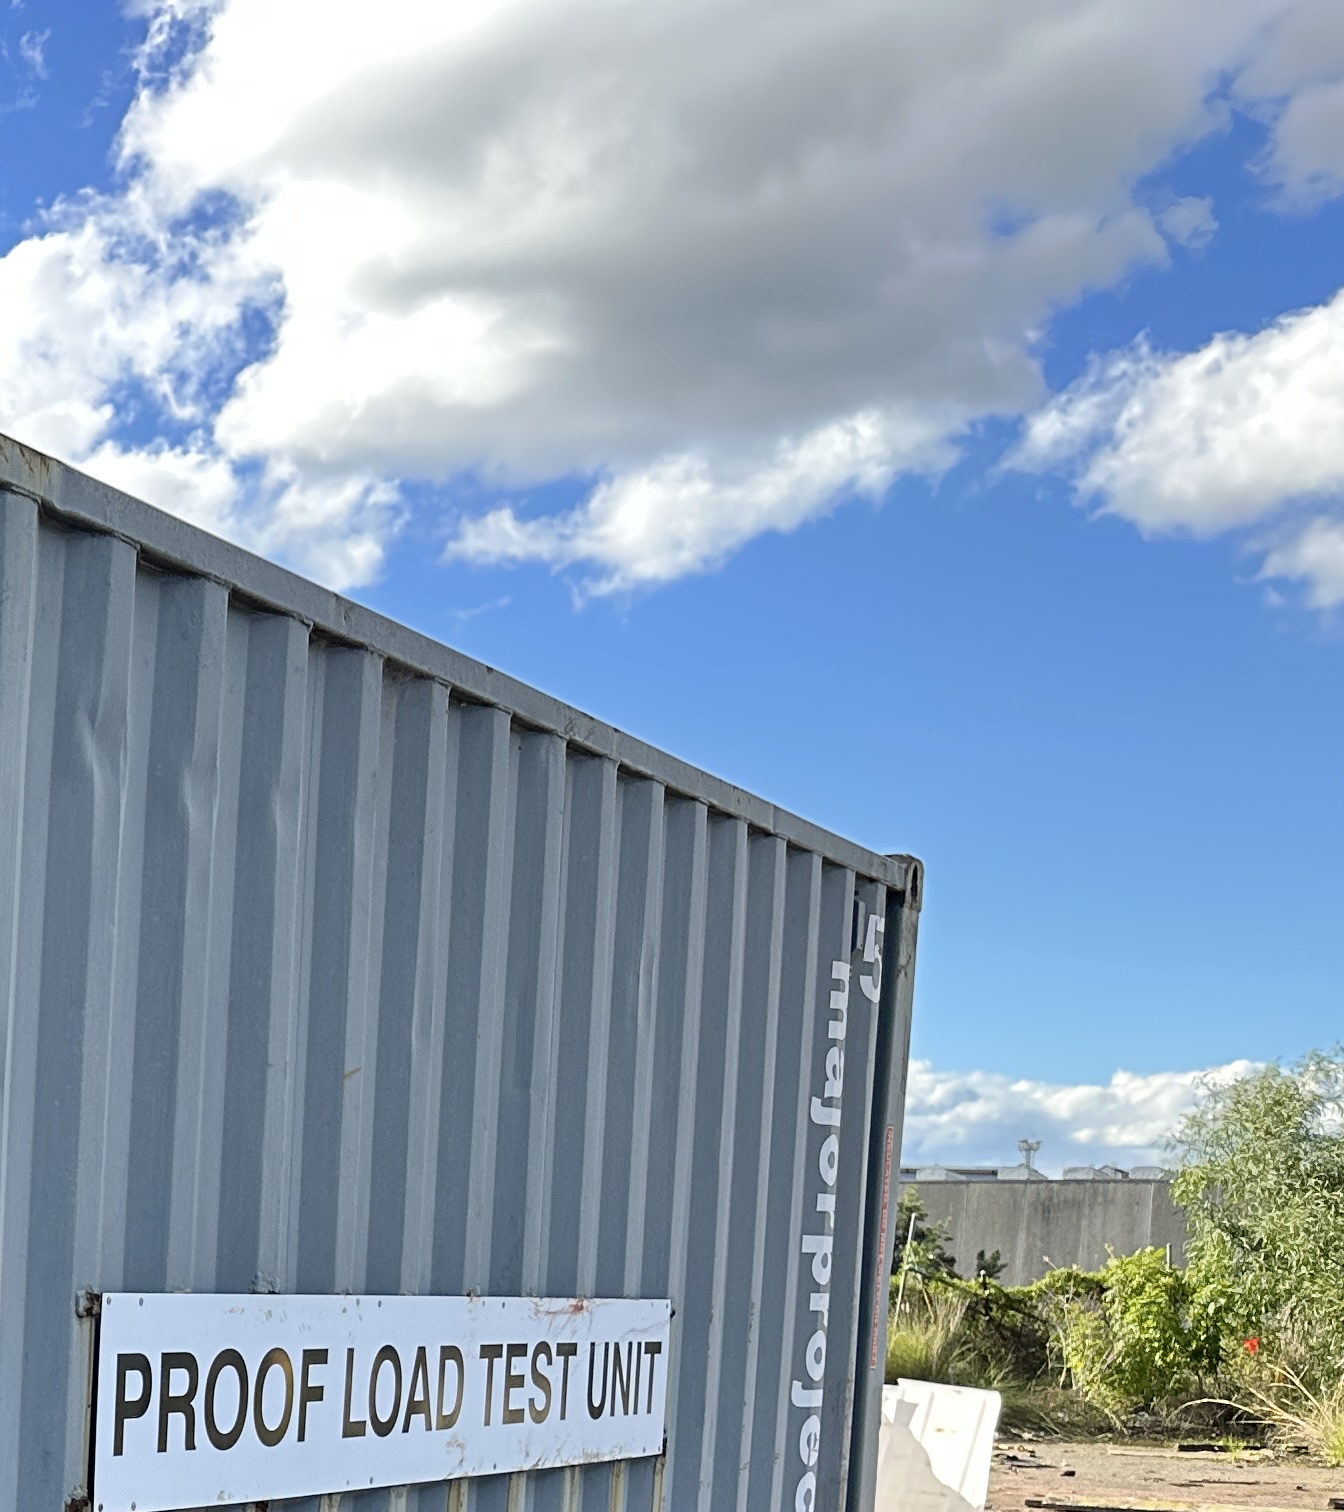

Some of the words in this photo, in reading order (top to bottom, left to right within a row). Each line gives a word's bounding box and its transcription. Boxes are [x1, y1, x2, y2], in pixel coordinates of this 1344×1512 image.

[113, 1348, 328, 1456] PROOF
[342, 1345, 464, 1438] LOAD
[479, 1341, 577, 1426] TEST
[587, 1341, 662, 1420] UNIT
